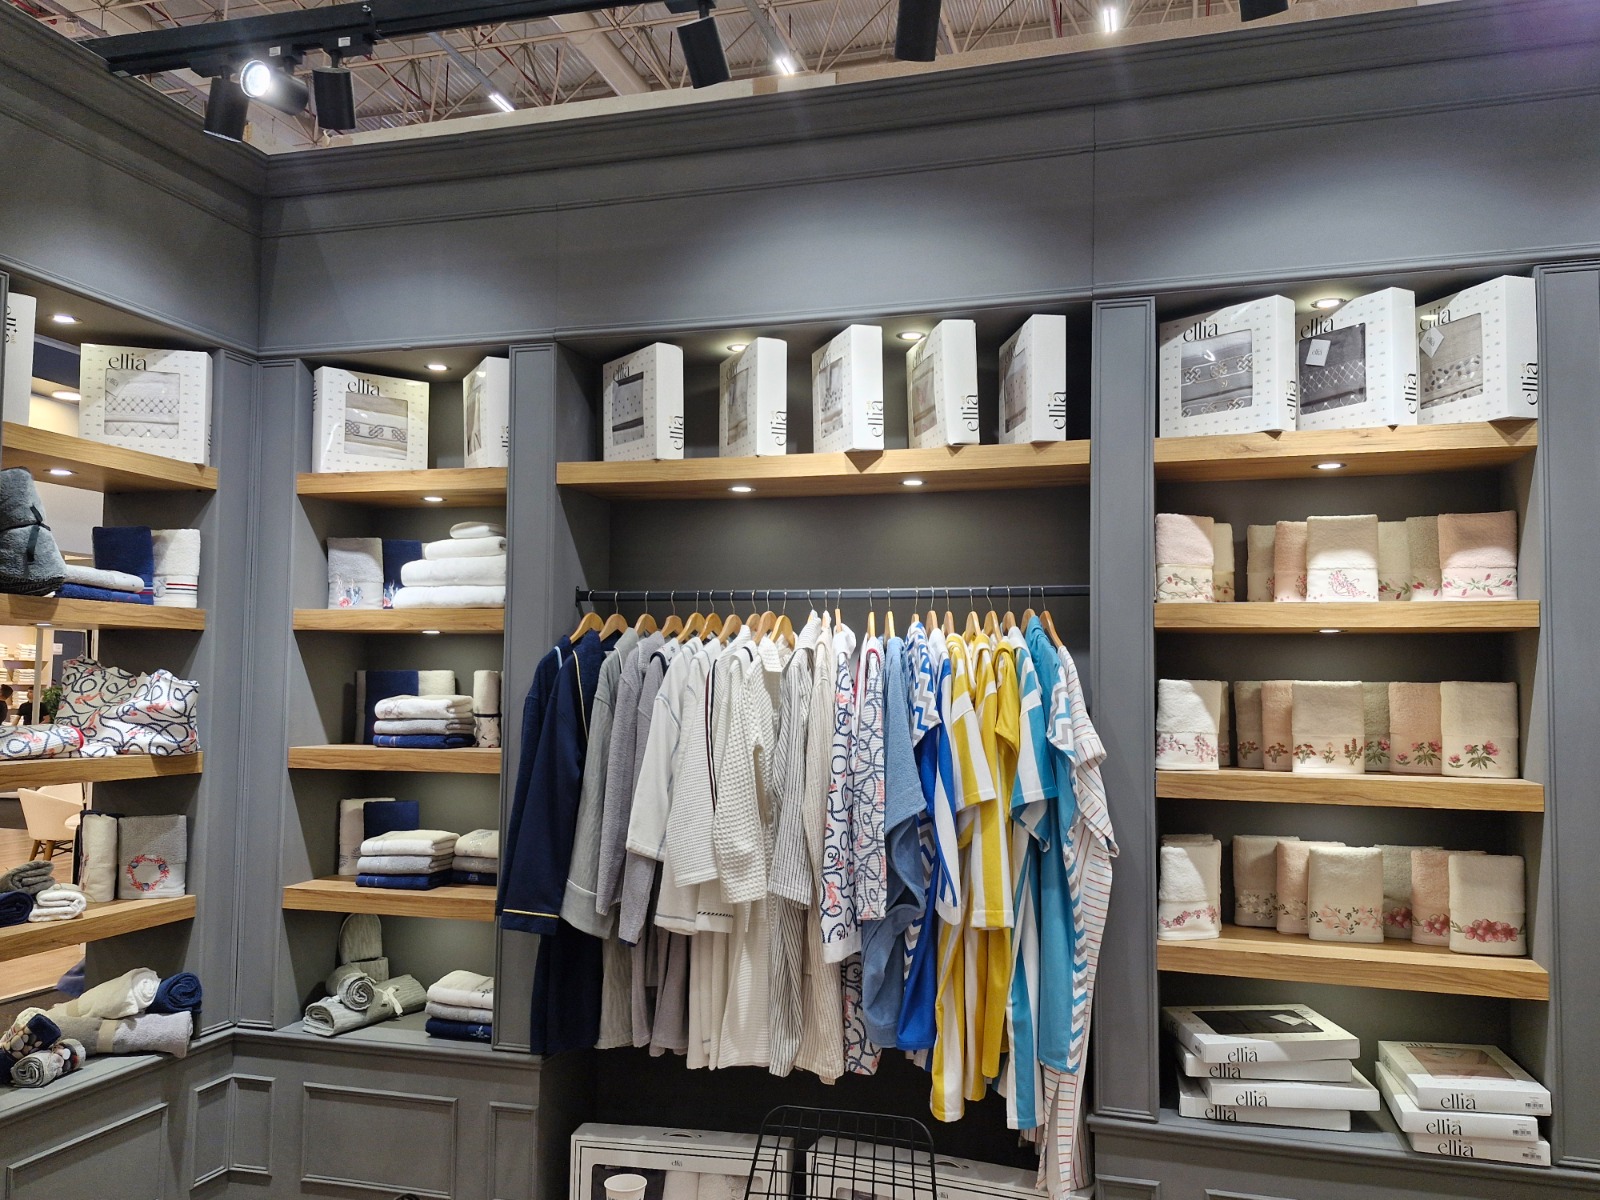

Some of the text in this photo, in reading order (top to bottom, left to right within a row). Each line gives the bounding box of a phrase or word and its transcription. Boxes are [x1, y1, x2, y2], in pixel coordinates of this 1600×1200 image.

[1300, 315, 1334, 339] ellia
[1420, 306, 1451, 331] ellia
[1183, 319, 1218, 342] ellia
[108, 352, 147, 371] ellia
[613, 361, 630, 381] ellia
[347, 378, 380, 397] ellia
[1403, 373, 1417, 415] ellia
[1520, 362, 1538, 406] ellia
[1047, 391, 1066, 430] ellia
[1285, 380, 1296, 421] ellia
[866, 400, 884, 438] ellia
[960, 394, 979, 432] ellia
[669, 415, 684, 451] ellia
[770, 410, 787, 447] ellia
[1227, 1046, 1258, 1063] ellia
[1209, 1062, 1241, 1079] ellia
[1235, 1090, 1268, 1107] ellia
[1440, 1092, 1476, 1110] ellia
[1204, 1105, 1237, 1122] ellia
[1426, 1118, 1462, 1136] ellia
[1437, 1139, 1474, 1158] ellia
